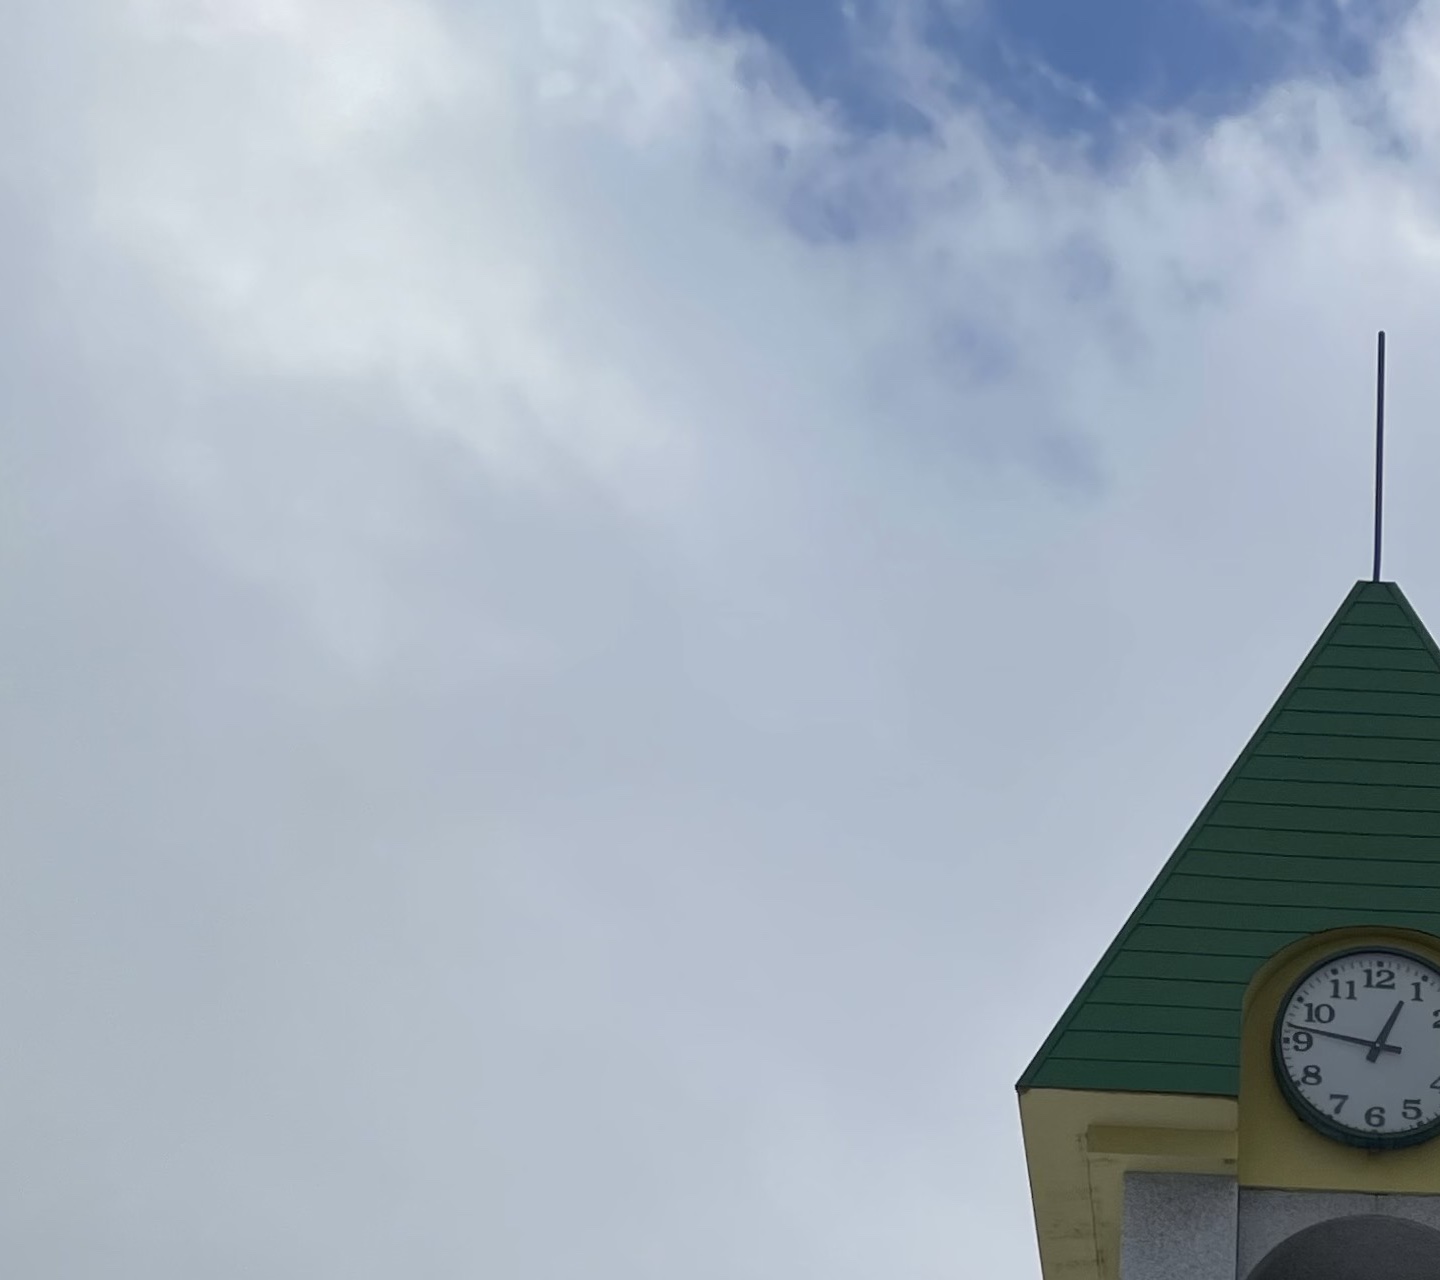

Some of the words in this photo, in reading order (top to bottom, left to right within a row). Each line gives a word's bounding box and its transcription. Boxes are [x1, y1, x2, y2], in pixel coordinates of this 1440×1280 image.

[1330, 978, 1358, 1001] 11
[1362, 968, 1396, 990] 12
[1411, 982, 1424, 1002] 1
[1303, 1002, 1335, 1024] 10
[1292, 1031, 1314, 1052] 9
[1301, 1064, 1323, 1086] 8
[1329, 1094, 1349, 1115] 7
[1401, 1098, 1423, 1120] 5
[1364, 1106, 1386, 1128] 6
